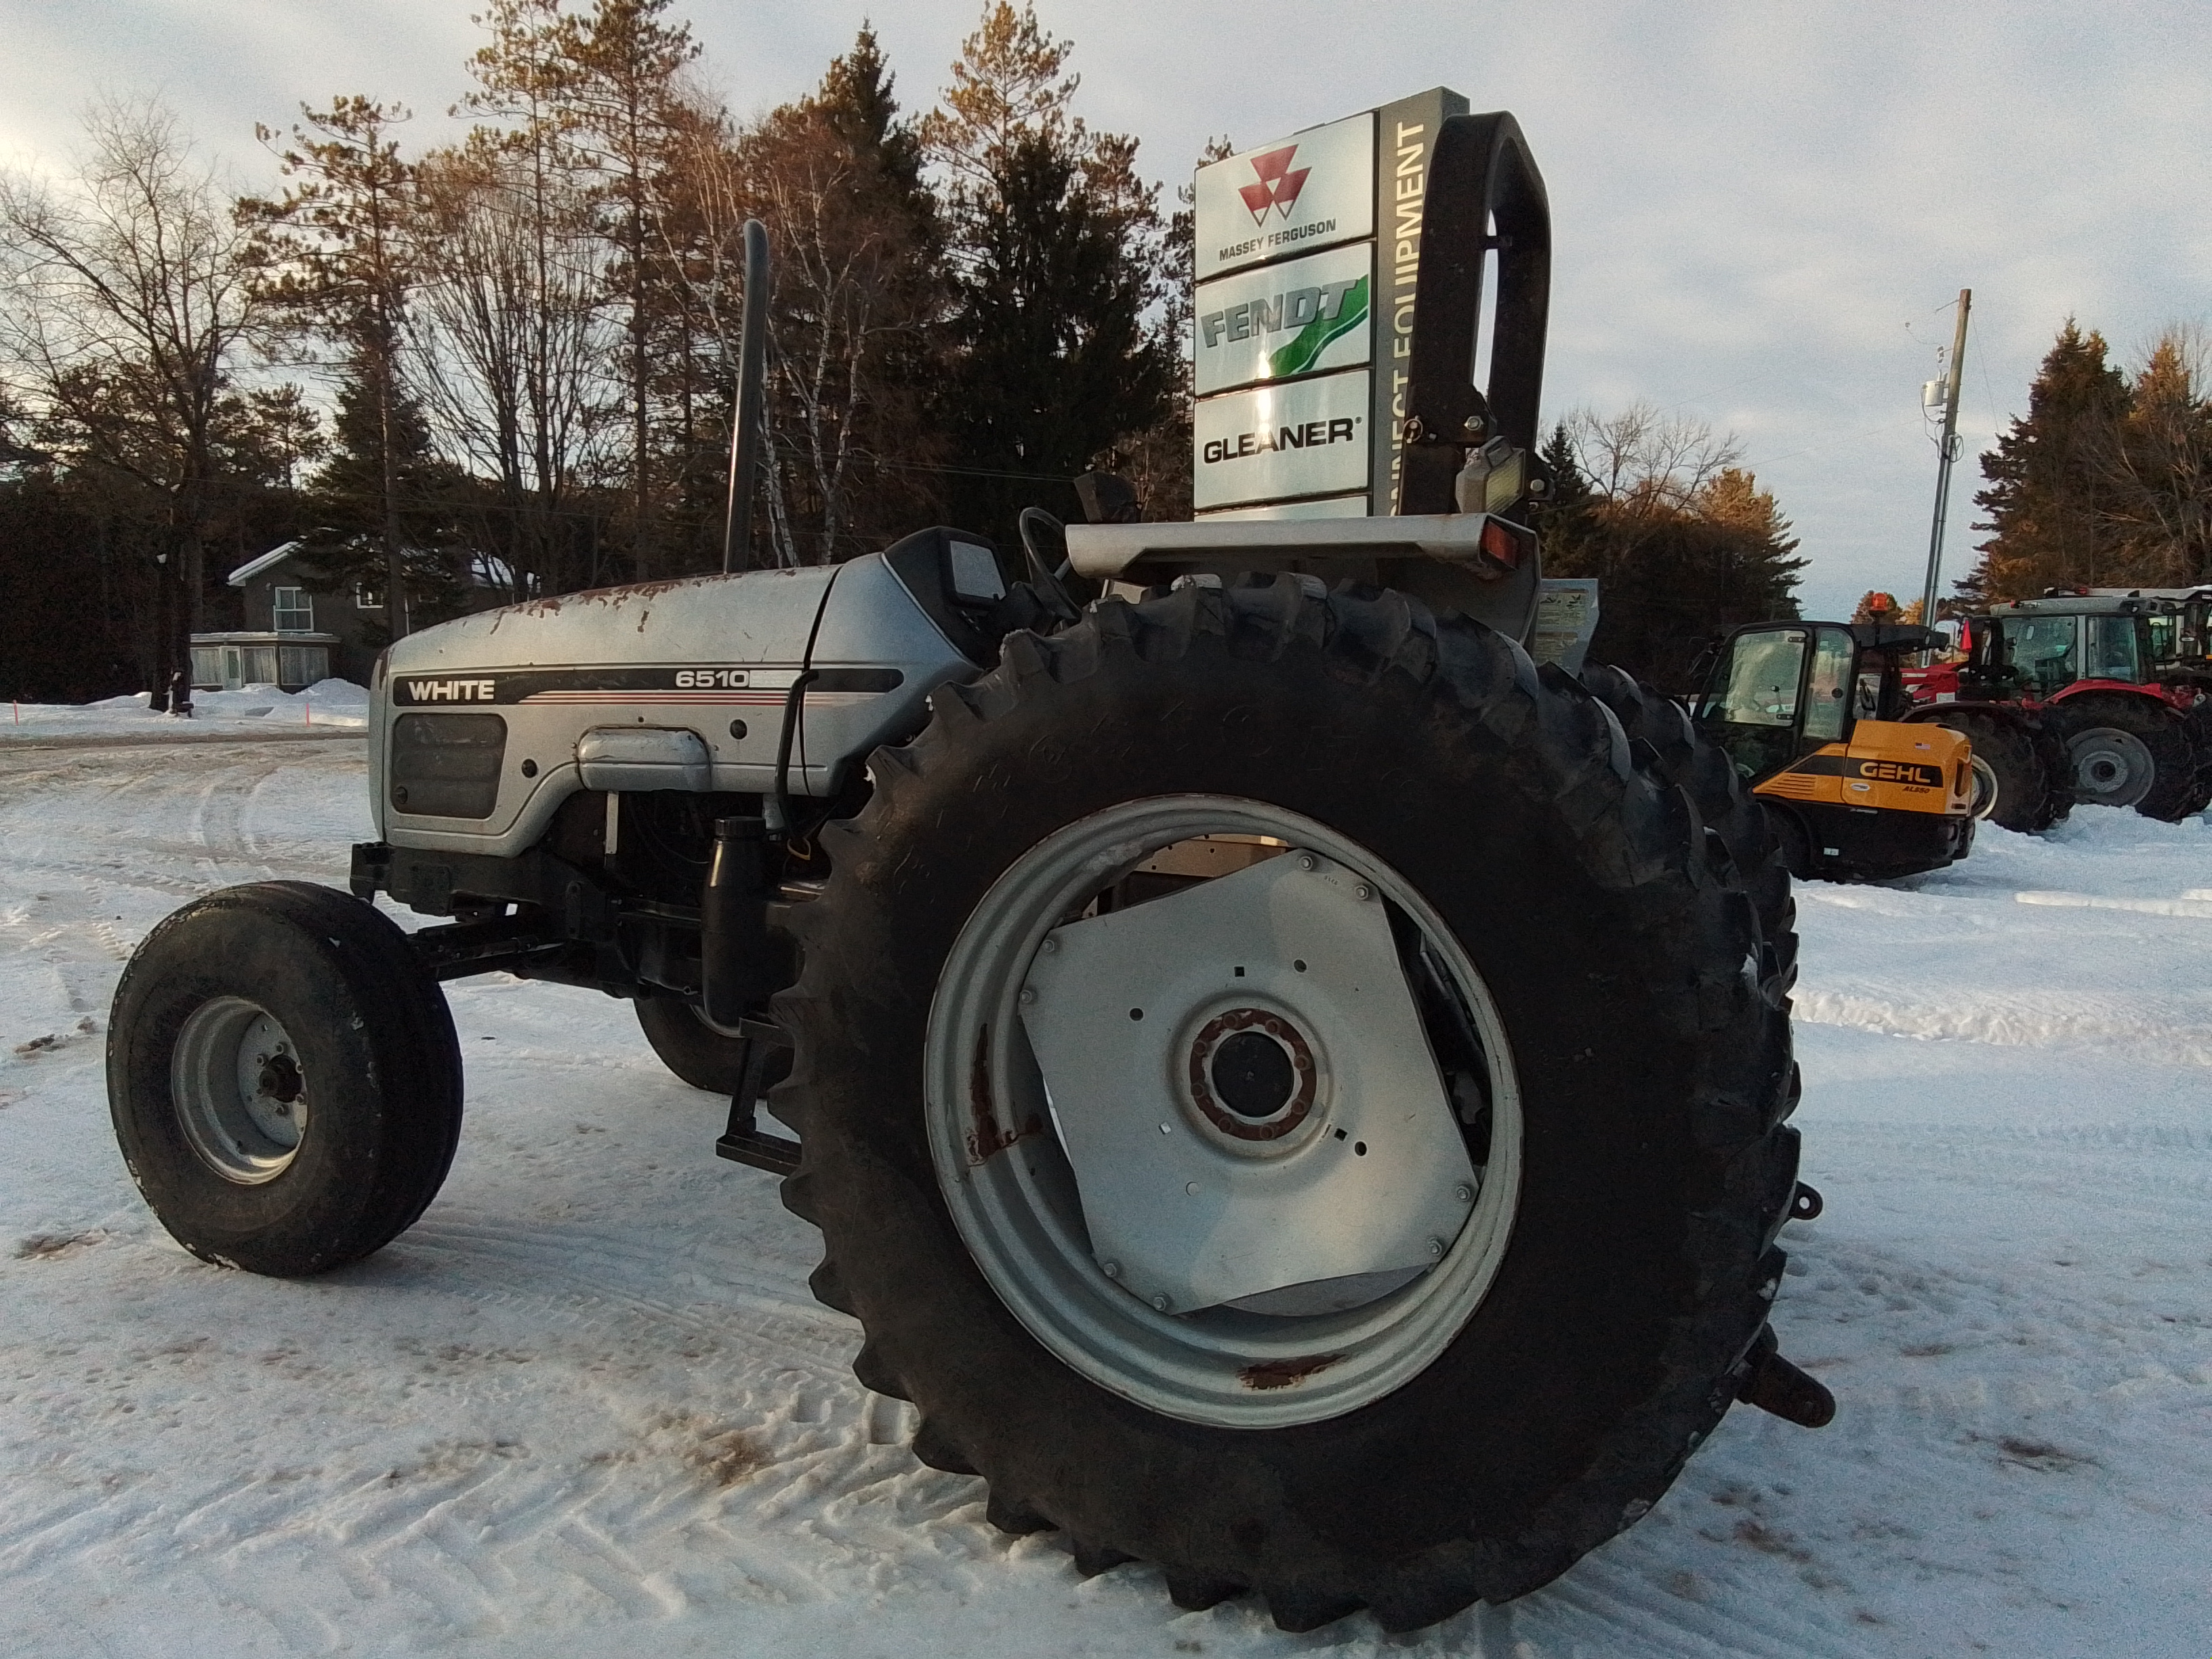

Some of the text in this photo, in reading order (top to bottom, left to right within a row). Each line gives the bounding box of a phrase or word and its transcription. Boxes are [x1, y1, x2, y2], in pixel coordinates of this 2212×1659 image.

[1219, 218, 1336, 262] MASSEY FERGUSON
[1200, 279, 1358, 348] FENDT
[1204, 417, 1354, 464] GLEANER
[408, 680, 495, 701] WHITE
[676, 670, 750, 688] 6510
[1860, 762, 1931, 783] GEHL
